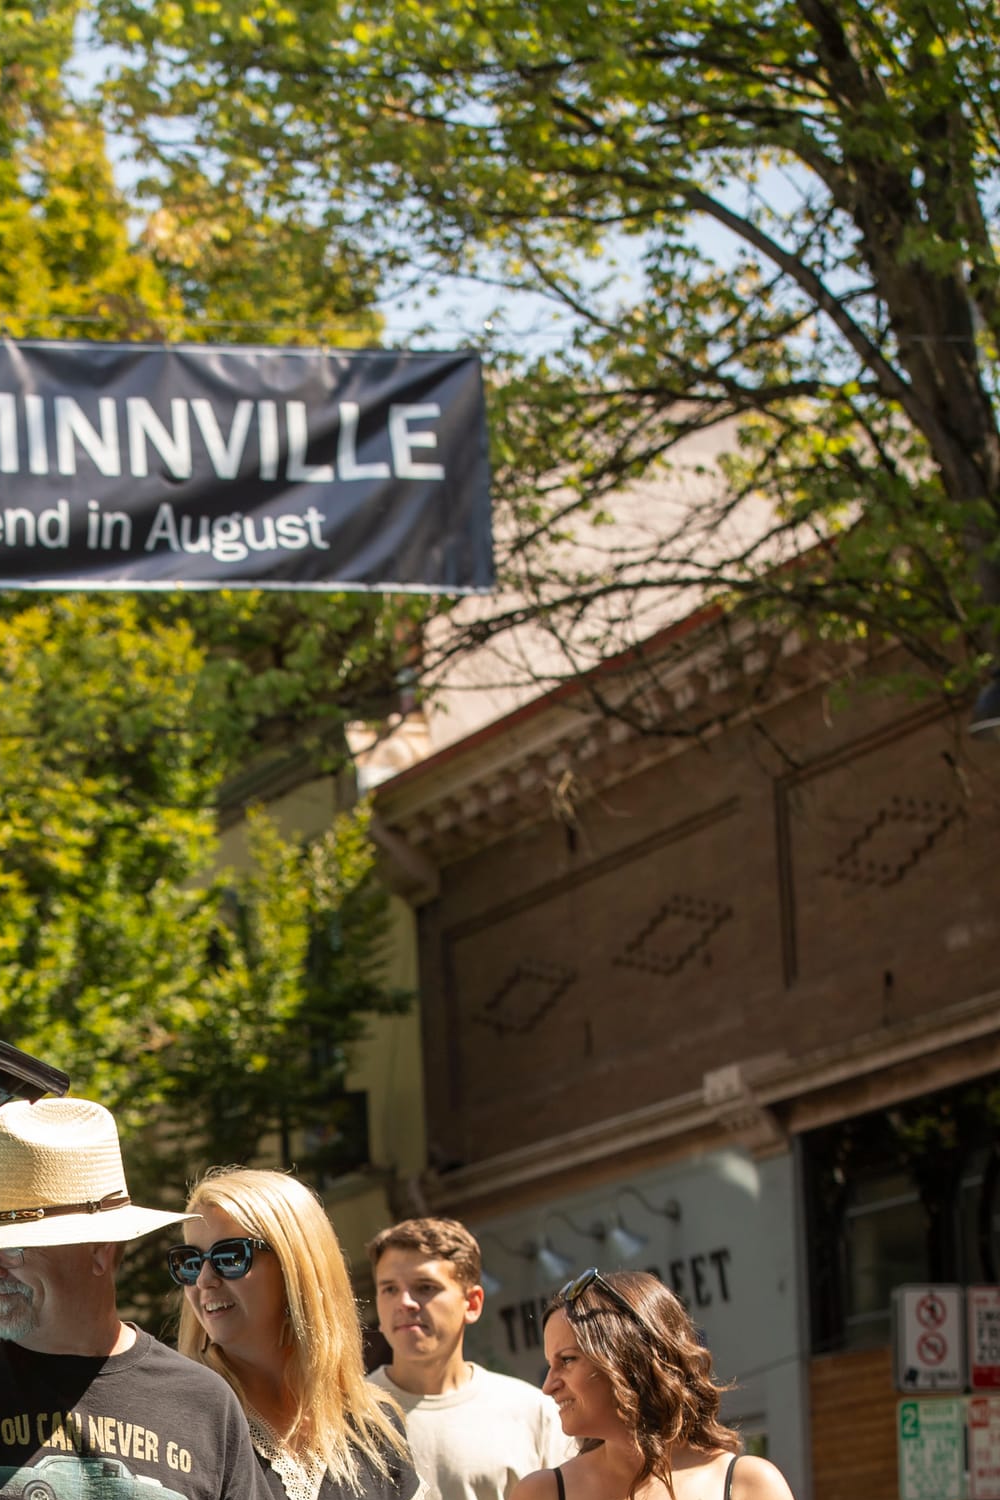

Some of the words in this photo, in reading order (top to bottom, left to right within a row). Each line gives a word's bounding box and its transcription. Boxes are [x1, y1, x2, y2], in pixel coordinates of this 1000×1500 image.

[88, 500, 132, 551] in
[145, 502, 330, 563] August
[37, 1411, 82, 1452] CAN
[88, 1415, 159, 1463] NEVER
[166, 1441, 192, 1473] GO
[903, 1407, 917, 1435] 2
